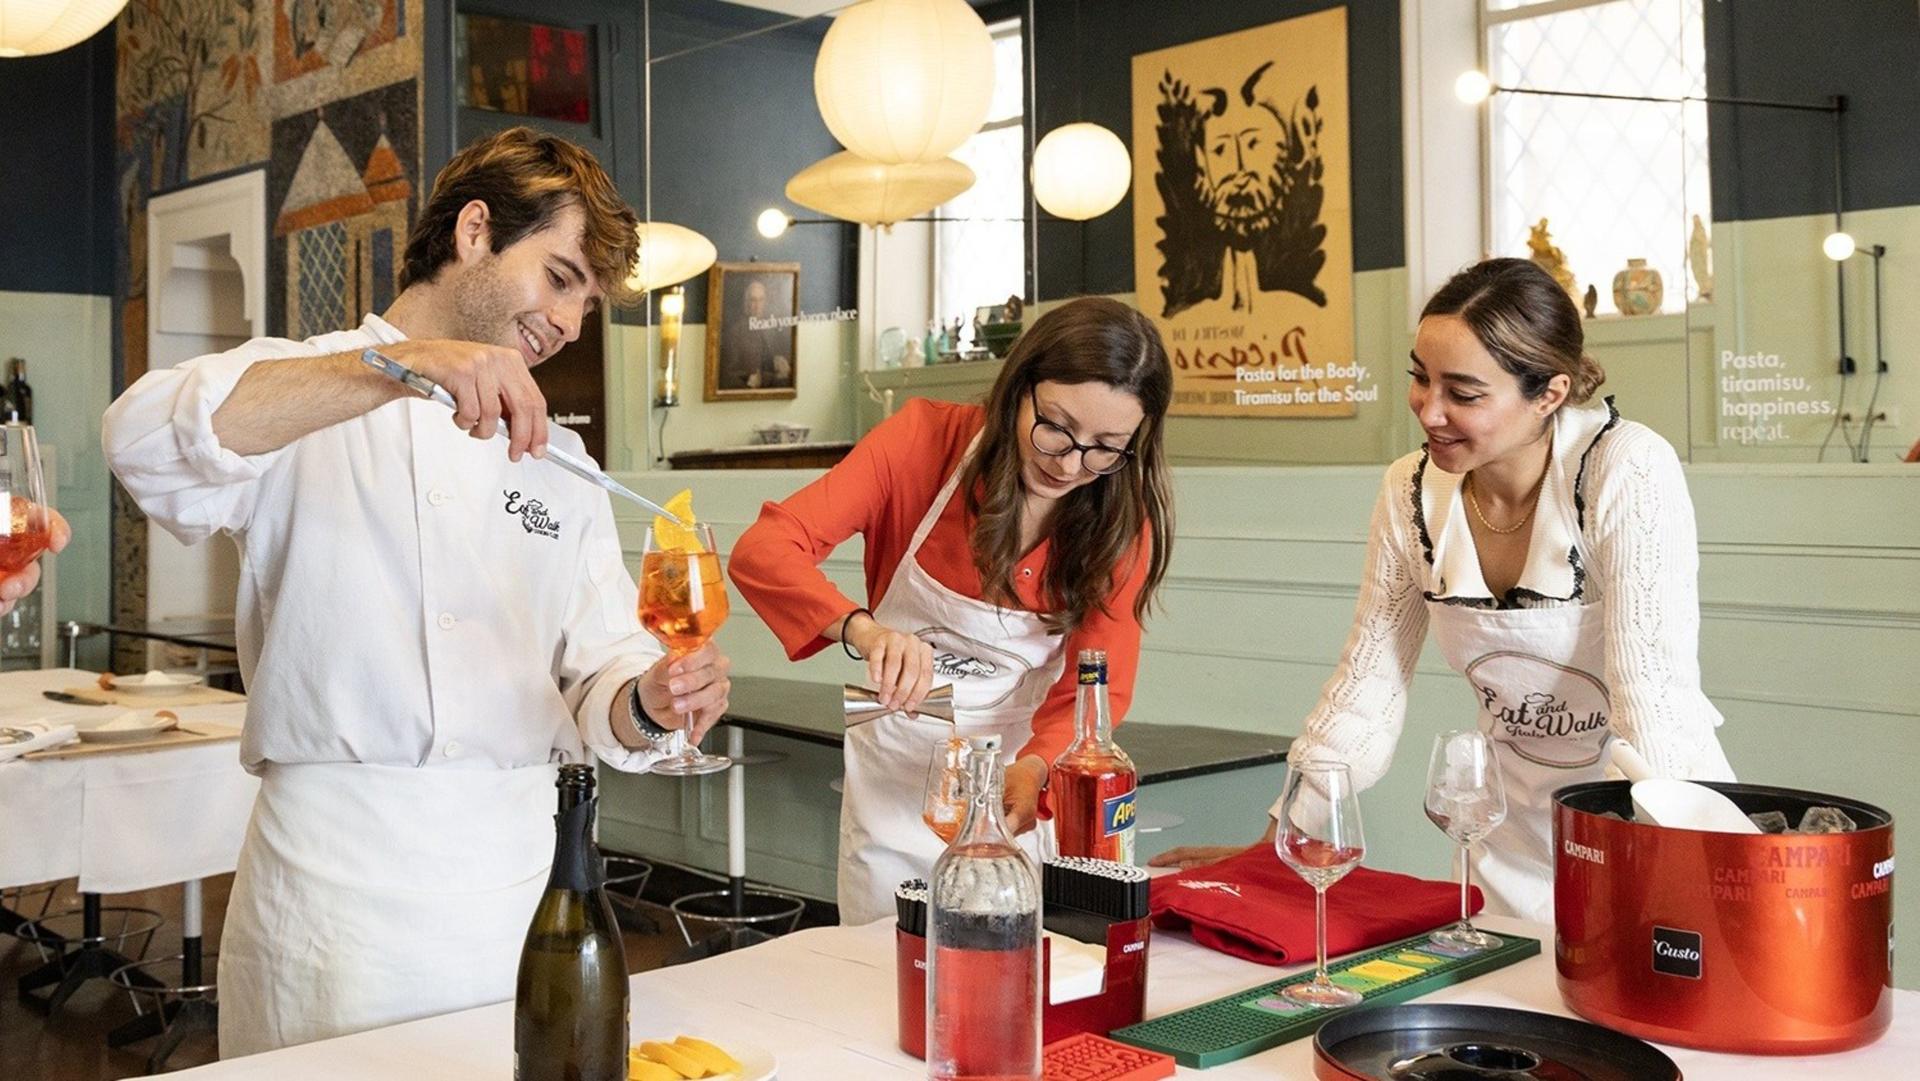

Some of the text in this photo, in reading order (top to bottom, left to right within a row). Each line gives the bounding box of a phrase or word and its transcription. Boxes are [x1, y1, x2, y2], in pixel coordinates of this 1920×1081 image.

[749, 313, 778, 331] Reach
[830, 305, 858, 325] place
[1721, 350, 1787, 369] Pasta,
[1236, 366, 1275, 383] Pasta
[1277, 364, 1297, 380] for
[1300, 363, 1324, 380] the
[1721, 373, 1812, 393] tiramisu,
[1234, 387, 1292, 406] Tiramisu
[1294, 386, 1315, 403] for
[1317, 385, 1341, 403] the
[1344, 383, 1378, 402] Soul
[1721, 397, 1838, 421] happiness,
[1722, 423, 1790, 444] repeat.
[1482, 686, 1568, 726] Eat and
[1535, 711, 1609, 737] Walk
[1564, 839, 1605, 865] CAMPARI
[1713, 867, 1786, 885] CAMARI
